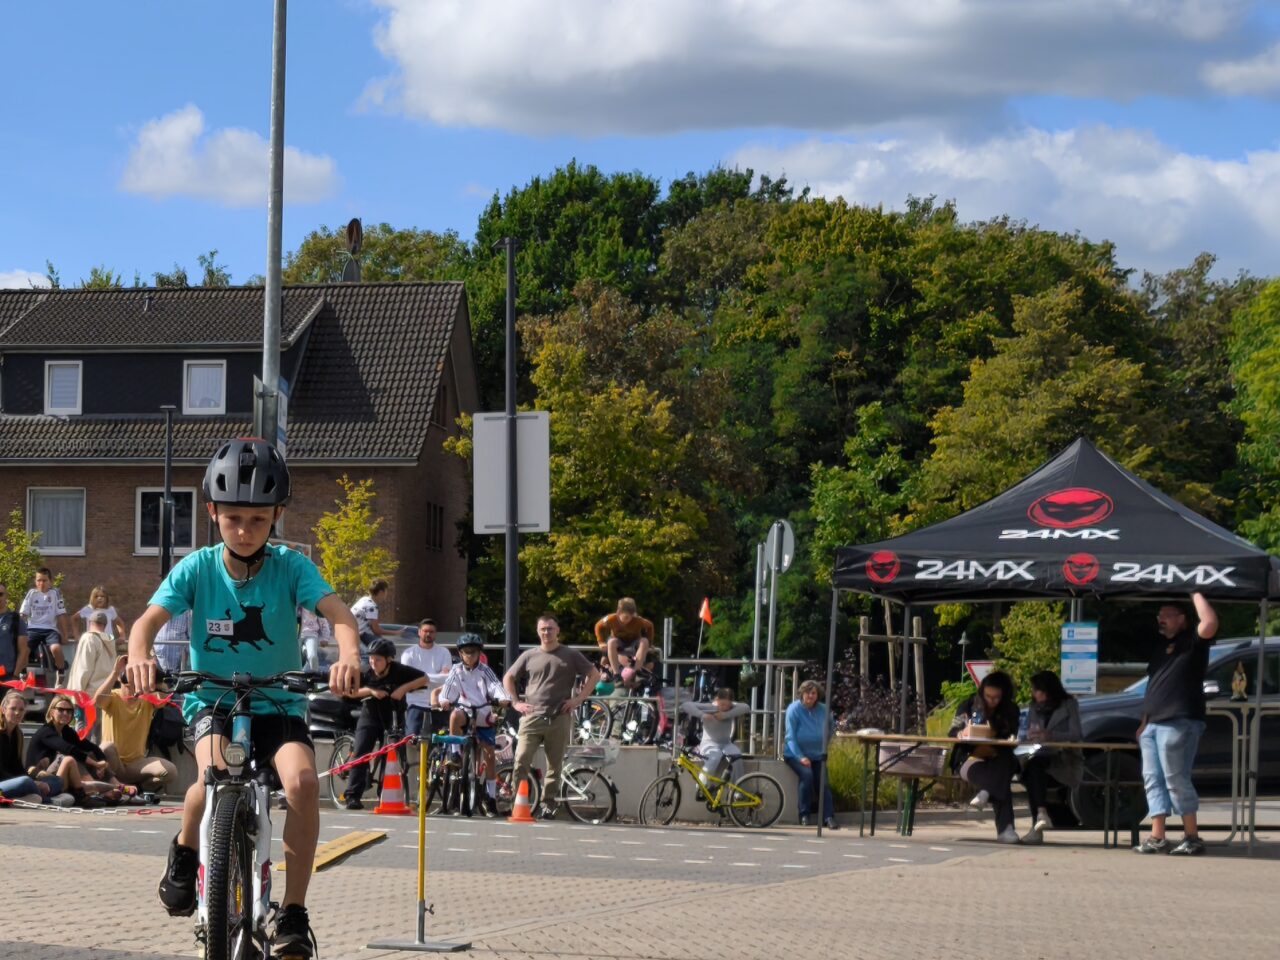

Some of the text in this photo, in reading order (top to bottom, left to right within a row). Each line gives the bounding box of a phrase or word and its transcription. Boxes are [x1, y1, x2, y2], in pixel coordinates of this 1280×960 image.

[998, 529, 1119, 540] 24MX
[915, 560, 1035, 580] 24MX
[1111, 562, 1236, 586] 24MX
[209, 622, 221, 632] 23
